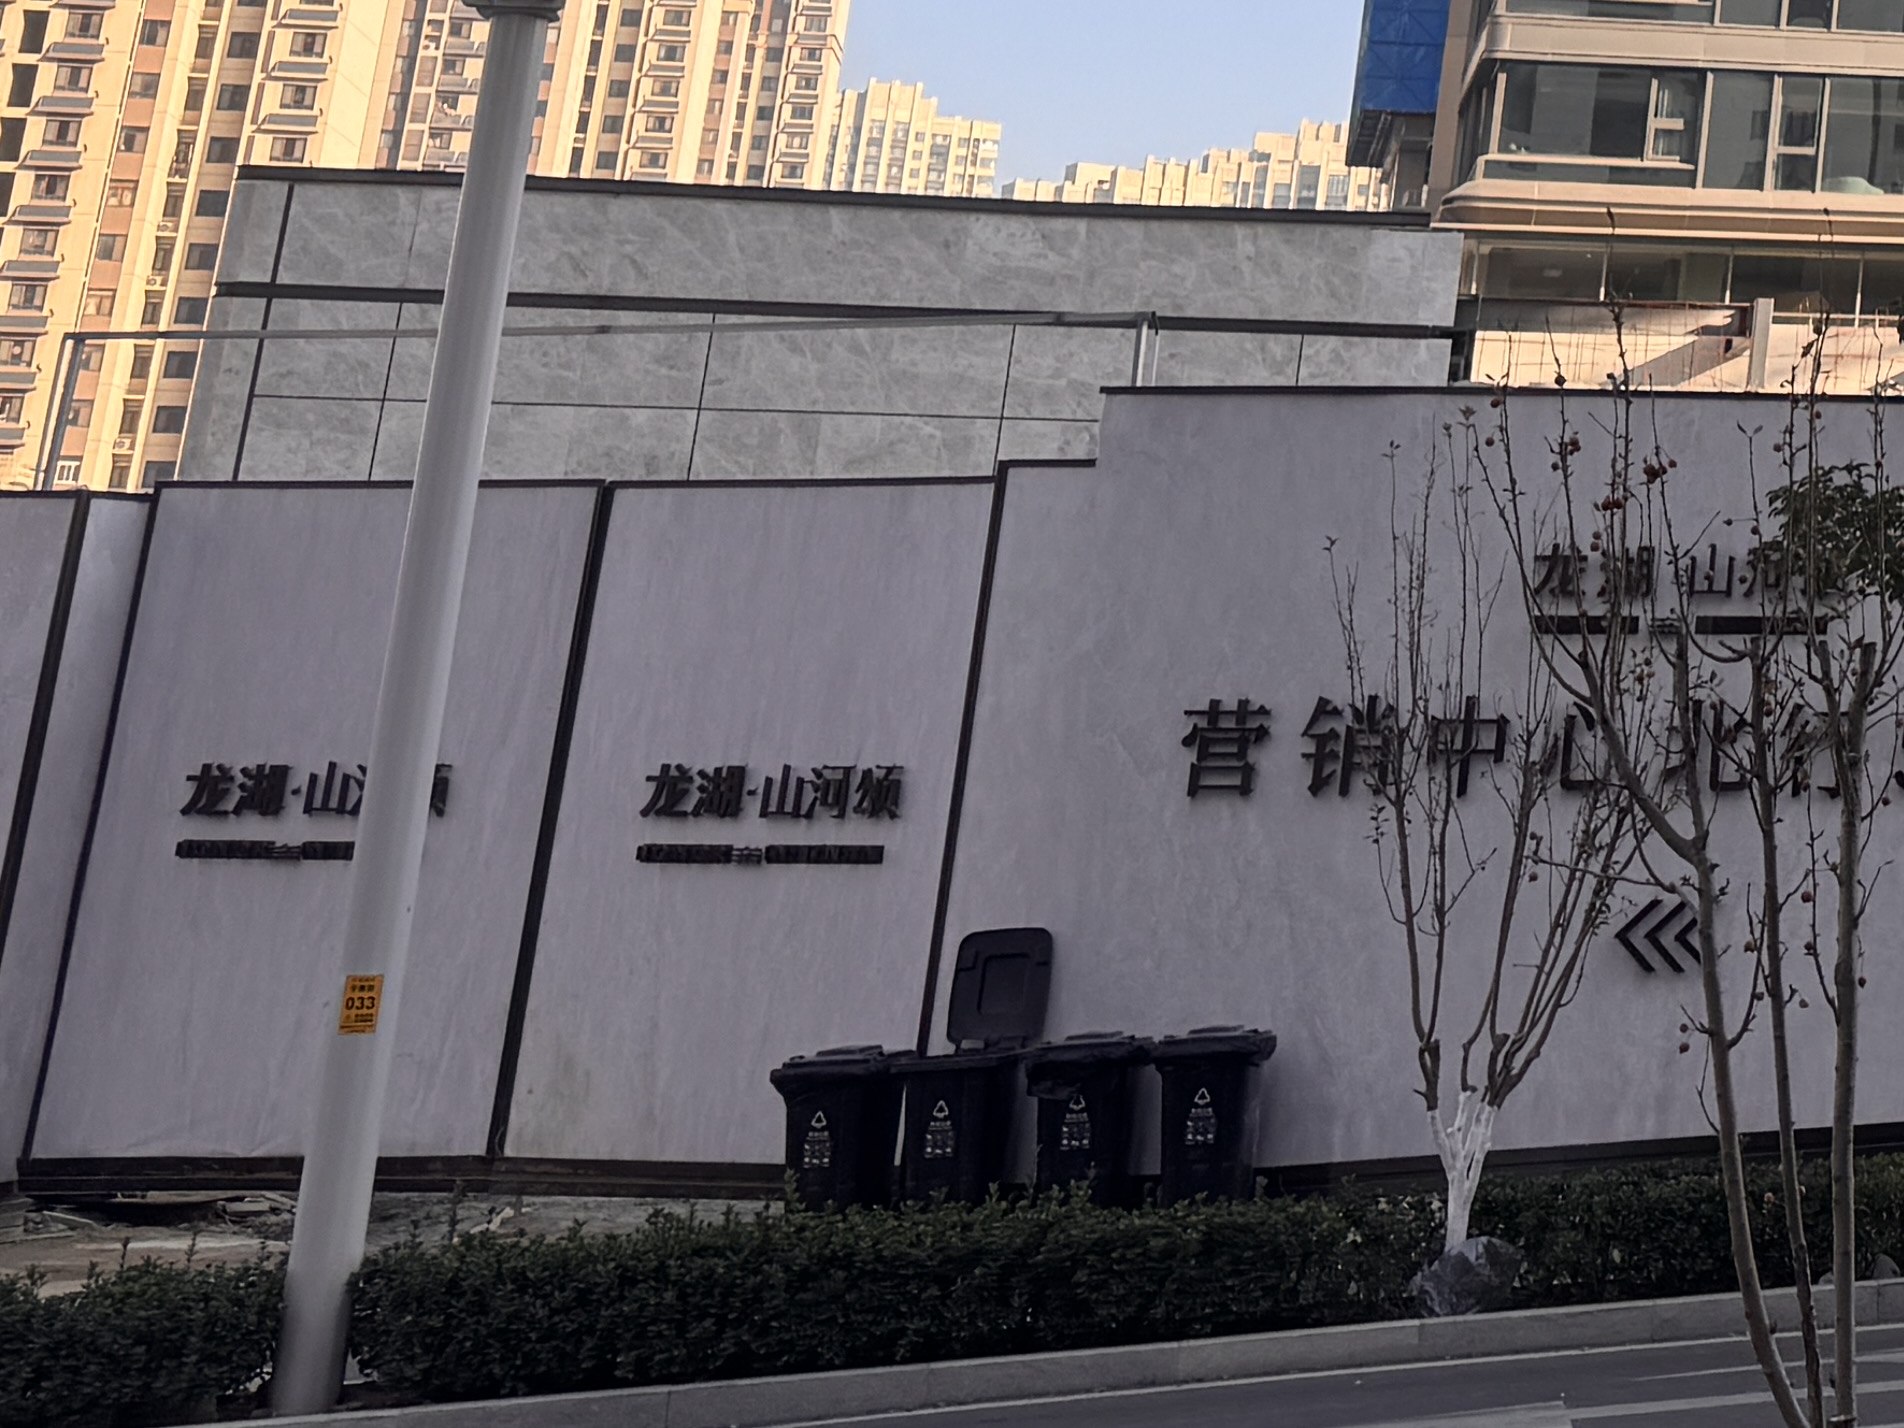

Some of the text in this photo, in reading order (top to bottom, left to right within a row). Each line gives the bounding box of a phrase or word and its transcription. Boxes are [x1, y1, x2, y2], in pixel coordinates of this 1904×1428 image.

[640, 763, 904, 820] 龙湖·山河颂
[345, 996, 376, 1011] 033
